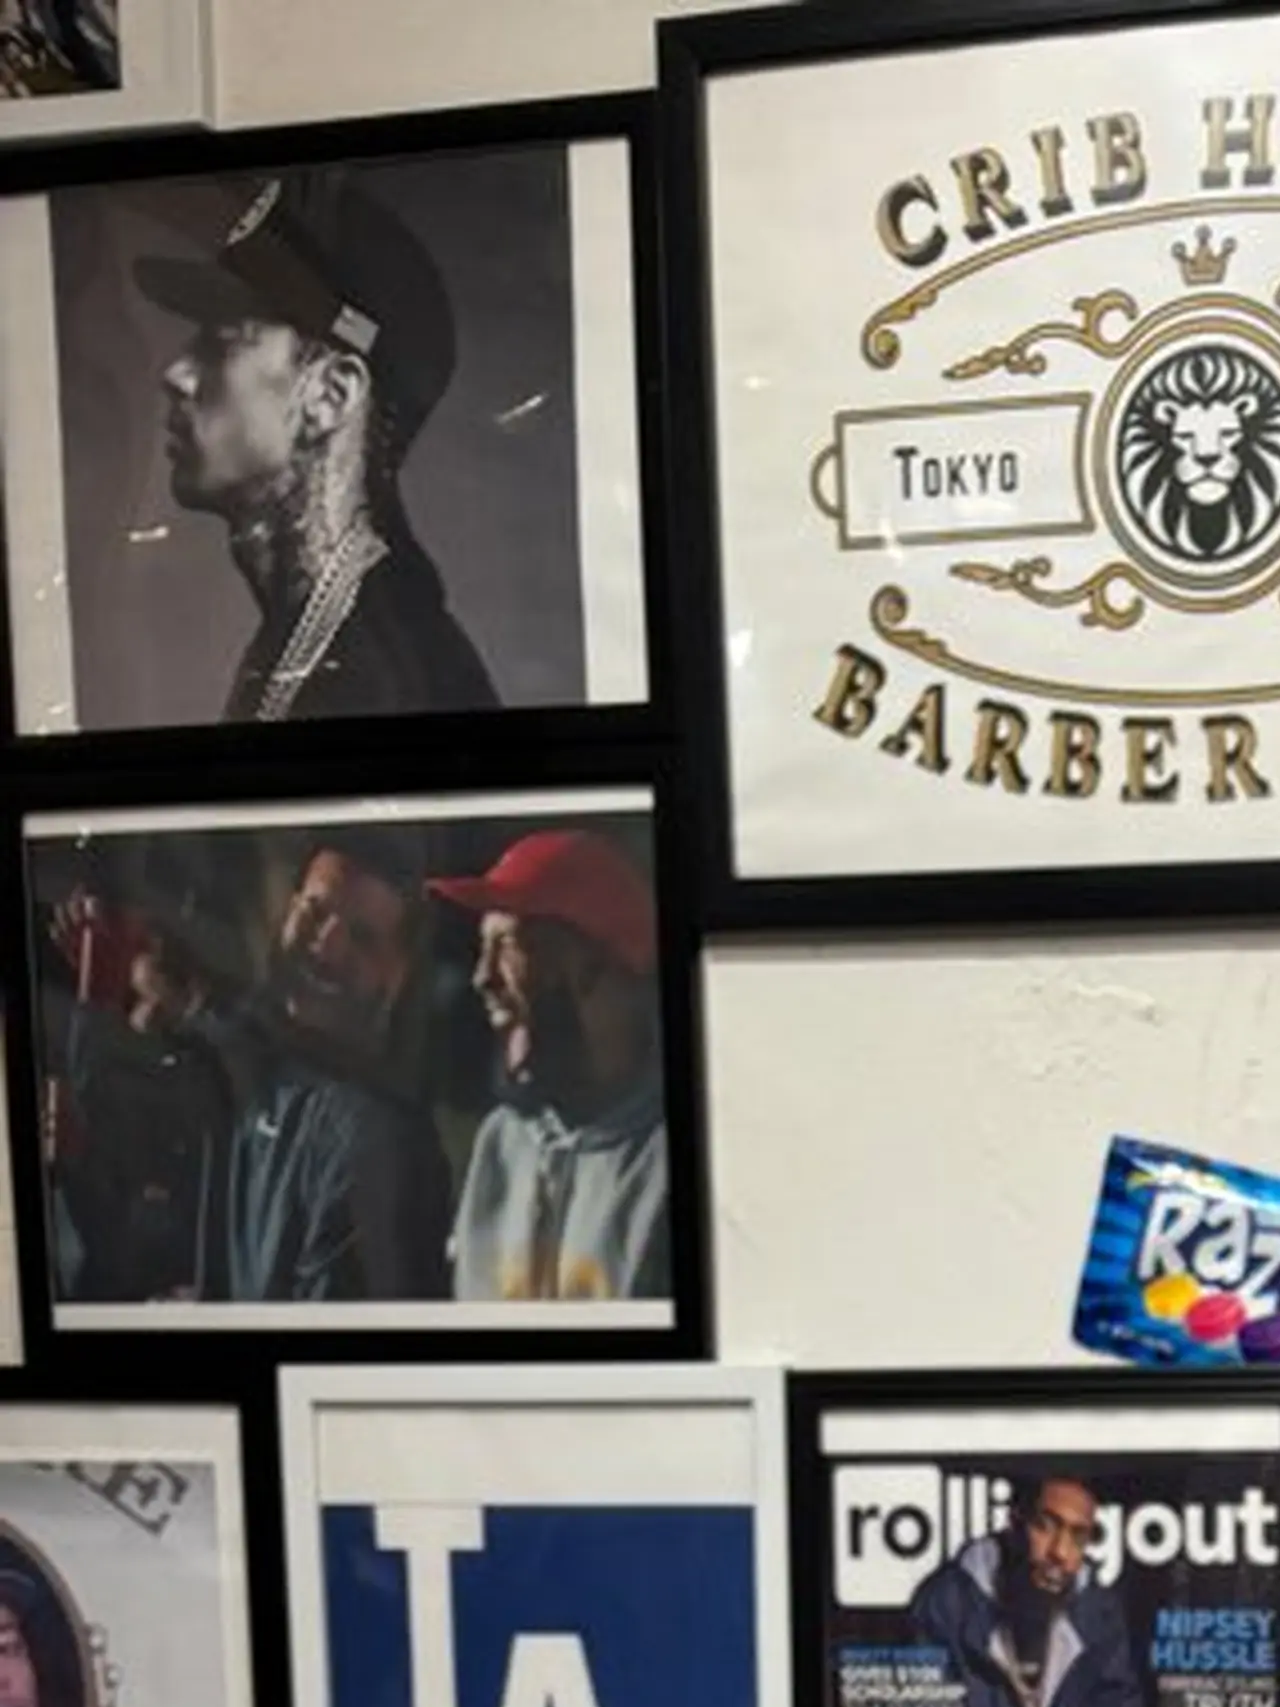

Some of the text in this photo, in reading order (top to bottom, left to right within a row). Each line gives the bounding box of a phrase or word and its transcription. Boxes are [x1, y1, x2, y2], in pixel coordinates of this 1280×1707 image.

[875, 111, 1149, 267] CRIB
[811, 642, 1272, 803] BARBER
[1150, 1640, 1277, 1670] HUSSLE
[1155, 1608, 1278, 1639] NIPSEY
